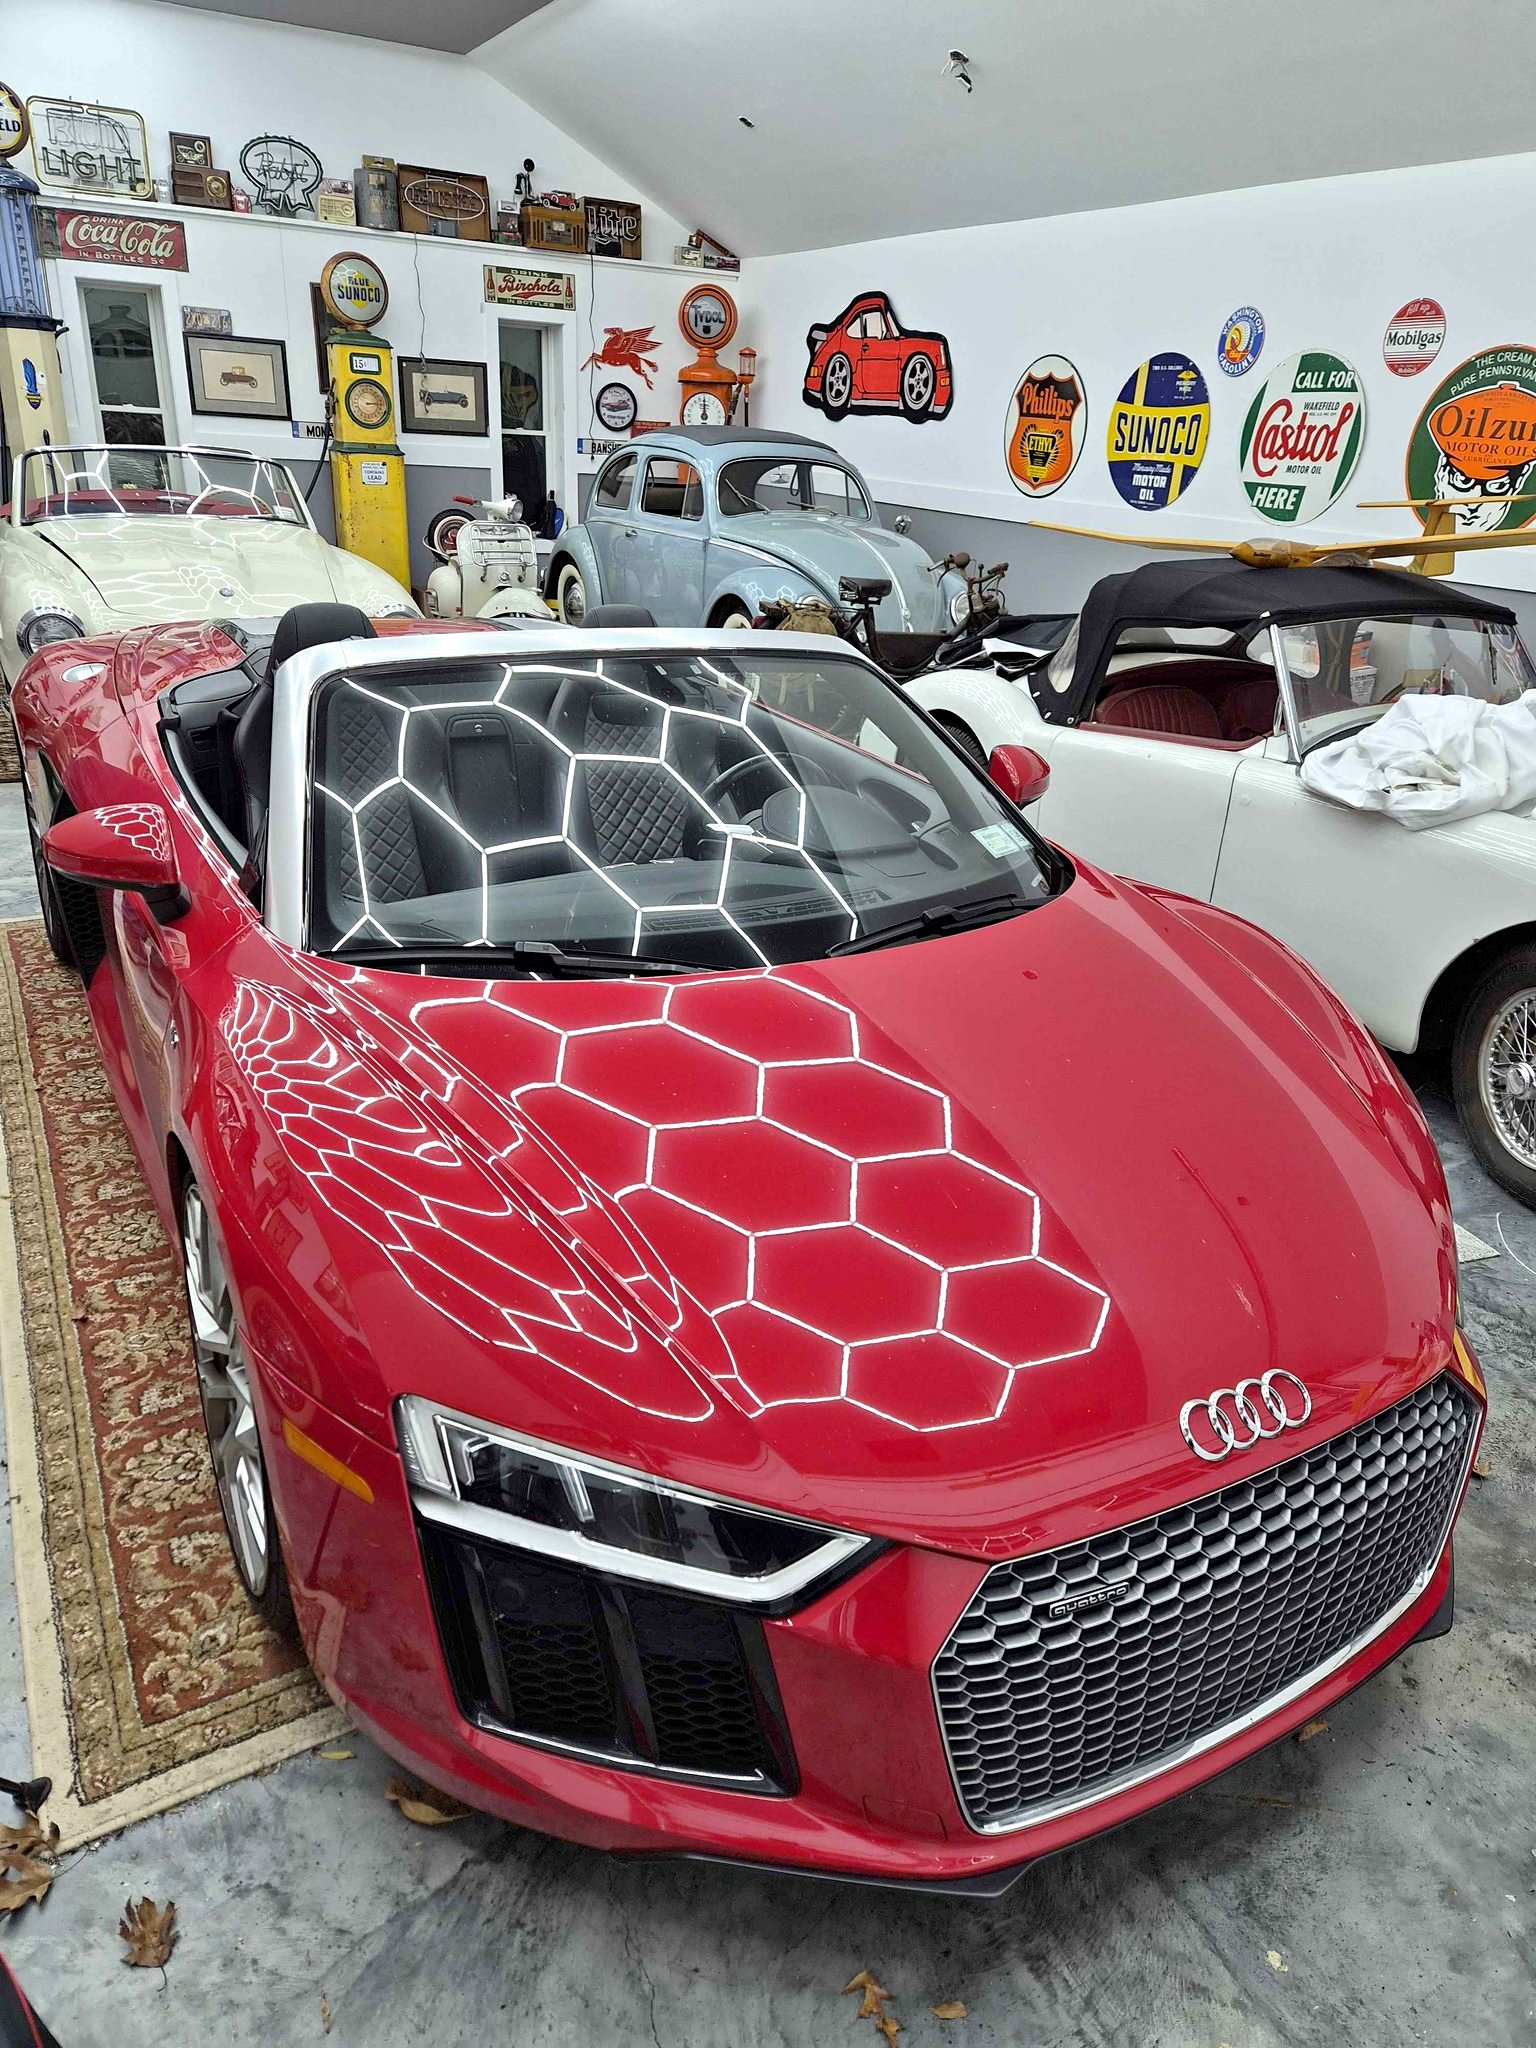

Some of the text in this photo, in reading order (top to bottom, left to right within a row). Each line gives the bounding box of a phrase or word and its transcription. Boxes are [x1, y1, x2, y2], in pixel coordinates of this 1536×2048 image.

[41, 147, 140, 185] LIGHT
[92, 216, 126, 226] DRINK
[585, 206, 640, 243] Lite
[79, 250, 89, 258] IN
[95, 252, 144, 264] BOTTLES
[347, 276, 370, 287] BLUE
[510, 269, 549, 278] DRINK
[337, 284, 381, 303] SUNOCO
[498, 274, 562, 295] Birchola
[1222, 308, 1264, 335] WASHINGTON
[1386, 330, 1442, 350] Mobilgas
[1219, 352, 1255, 373] GASOLINE
[1474, 354, 1496, 369] THE
[1496, 351, 1533, 365] CREAM
[1295, 370, 1355, 389] CALL FOR
[1450, 373, 1477, 396] PURE
[1022, 382, 1074, 424] Phillips
[1303, 401, 1341, 411] WAKEFIELD
[1115, 411, 1202, 456] SUNOCO
[1252, 398, 1354, 478] Castrol
[1028, 435, 1054, 452] ETHYL
[1445, 441, 1500, 455] MOTOR
[1285, 465, 1323, 475] MOTOR OIL
[1132, 473, 1168, 488] MOTOR
[1139, 488, 1155, 501] OIL
[1251, 486, 1300, 510] HERE
[1054, 1586, 1127, 1615] quattro
